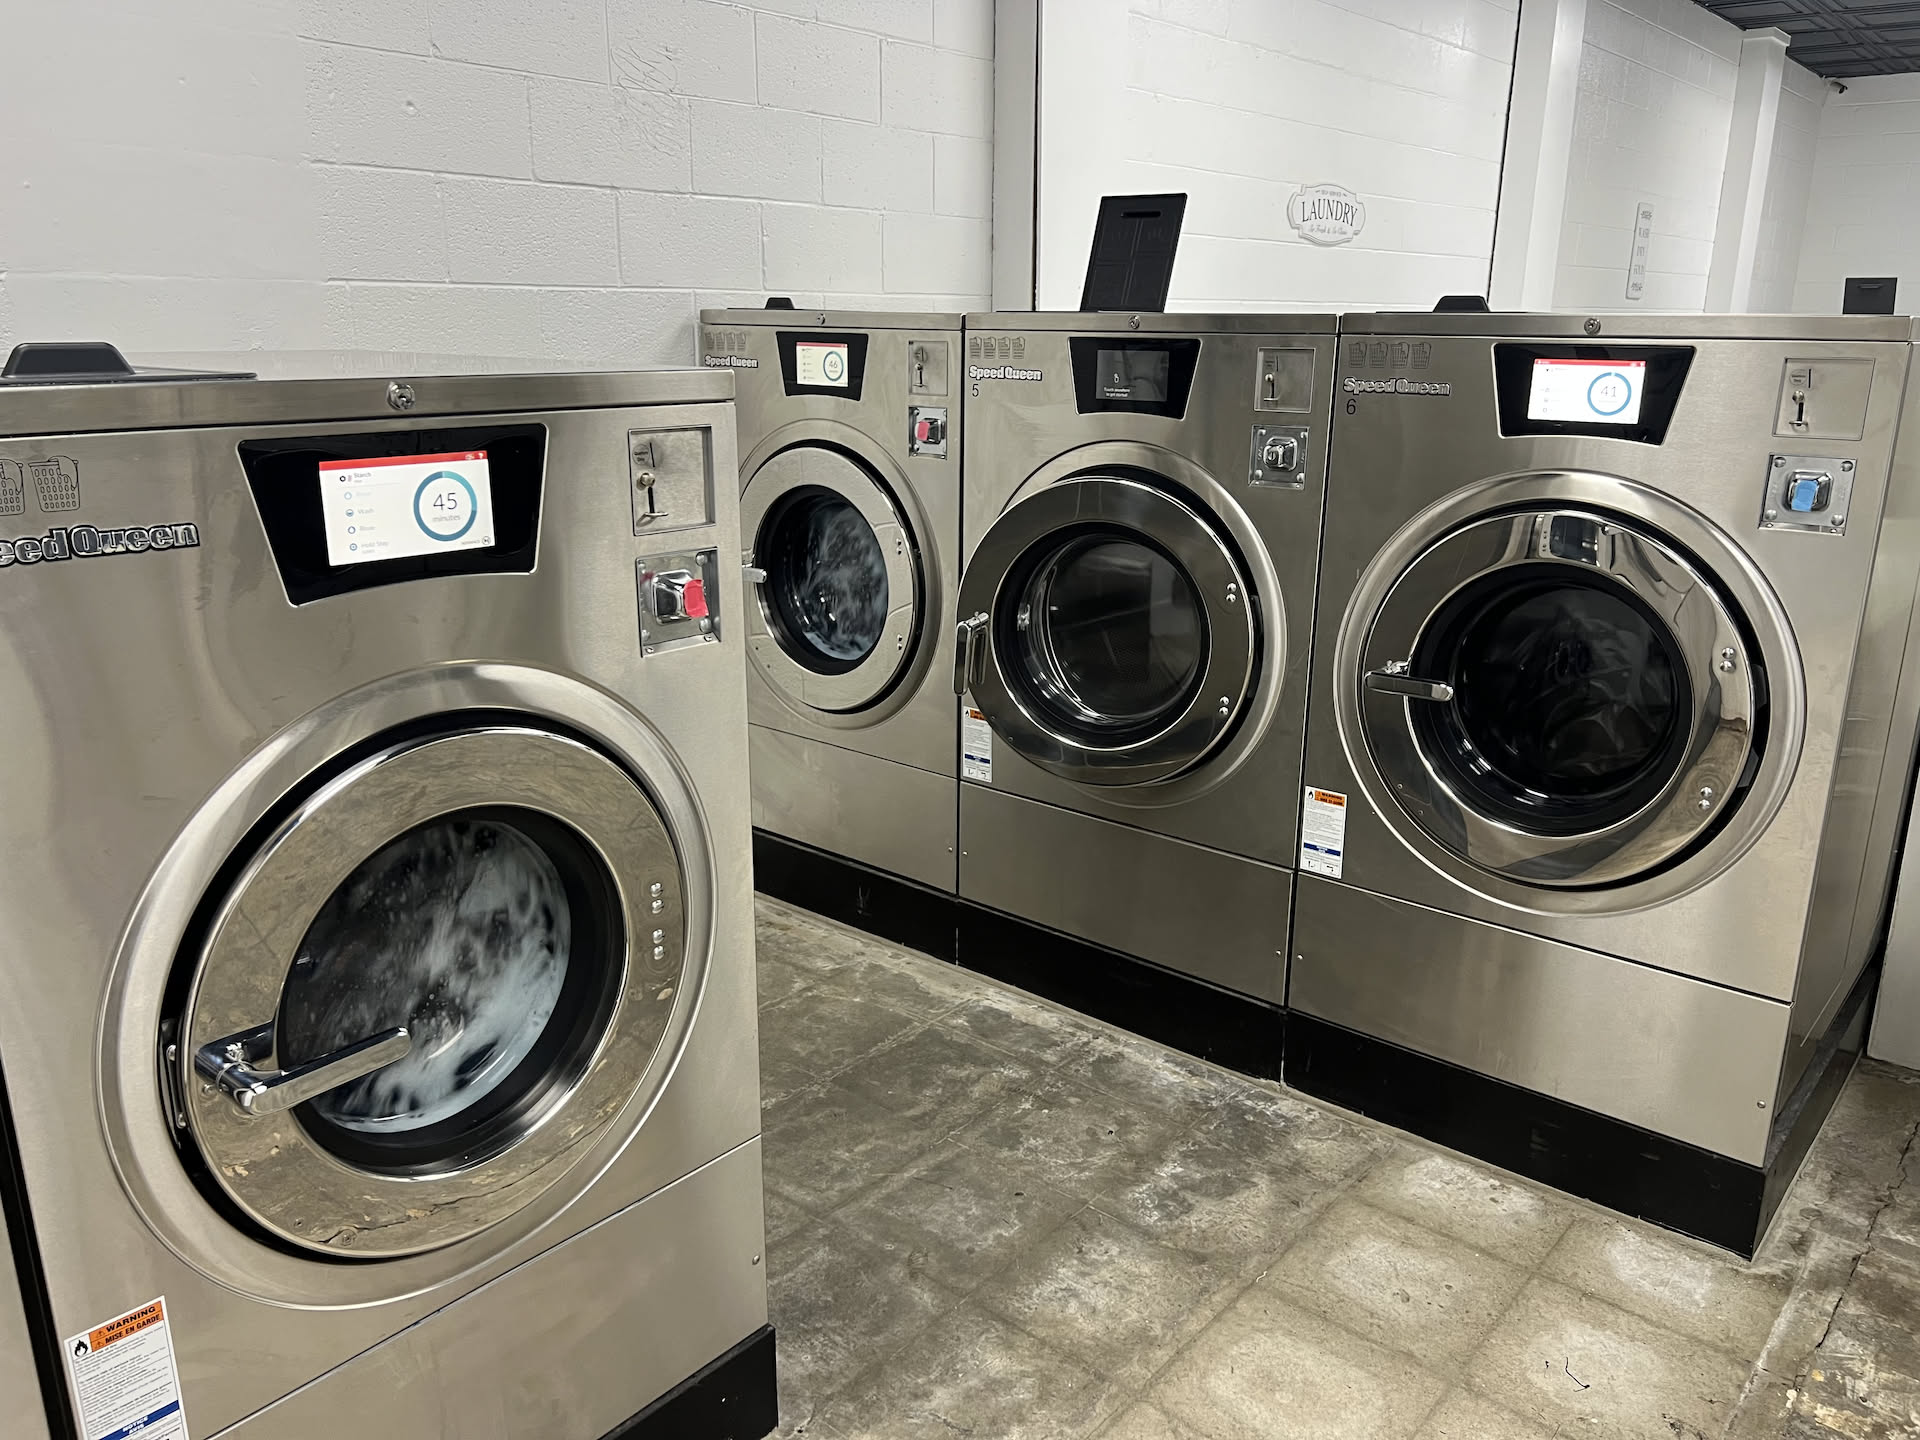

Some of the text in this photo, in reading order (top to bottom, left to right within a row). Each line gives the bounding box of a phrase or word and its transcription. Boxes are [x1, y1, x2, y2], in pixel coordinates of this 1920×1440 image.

[1301, 199, 1358, 226] LAUNDRY
[704, 354, 759, 368] Speed Queen
[969, 365, 1042, 381] Speed Queen
[972, 383, 979, 397] 5
[1343, 376, 1450, 396] Speed Queen
[1600, 386, 1617, 397] 41
[1346, 399, 1356, 414] 6
[433, 492, 458, 510] 45
[432, 514, 461, 522] minutes
[69, 523, 200, 558] Queen
[105, 1306, 156, 1332] WARNING
[105, 1314, 160, 1343] MISE EN GARDE
